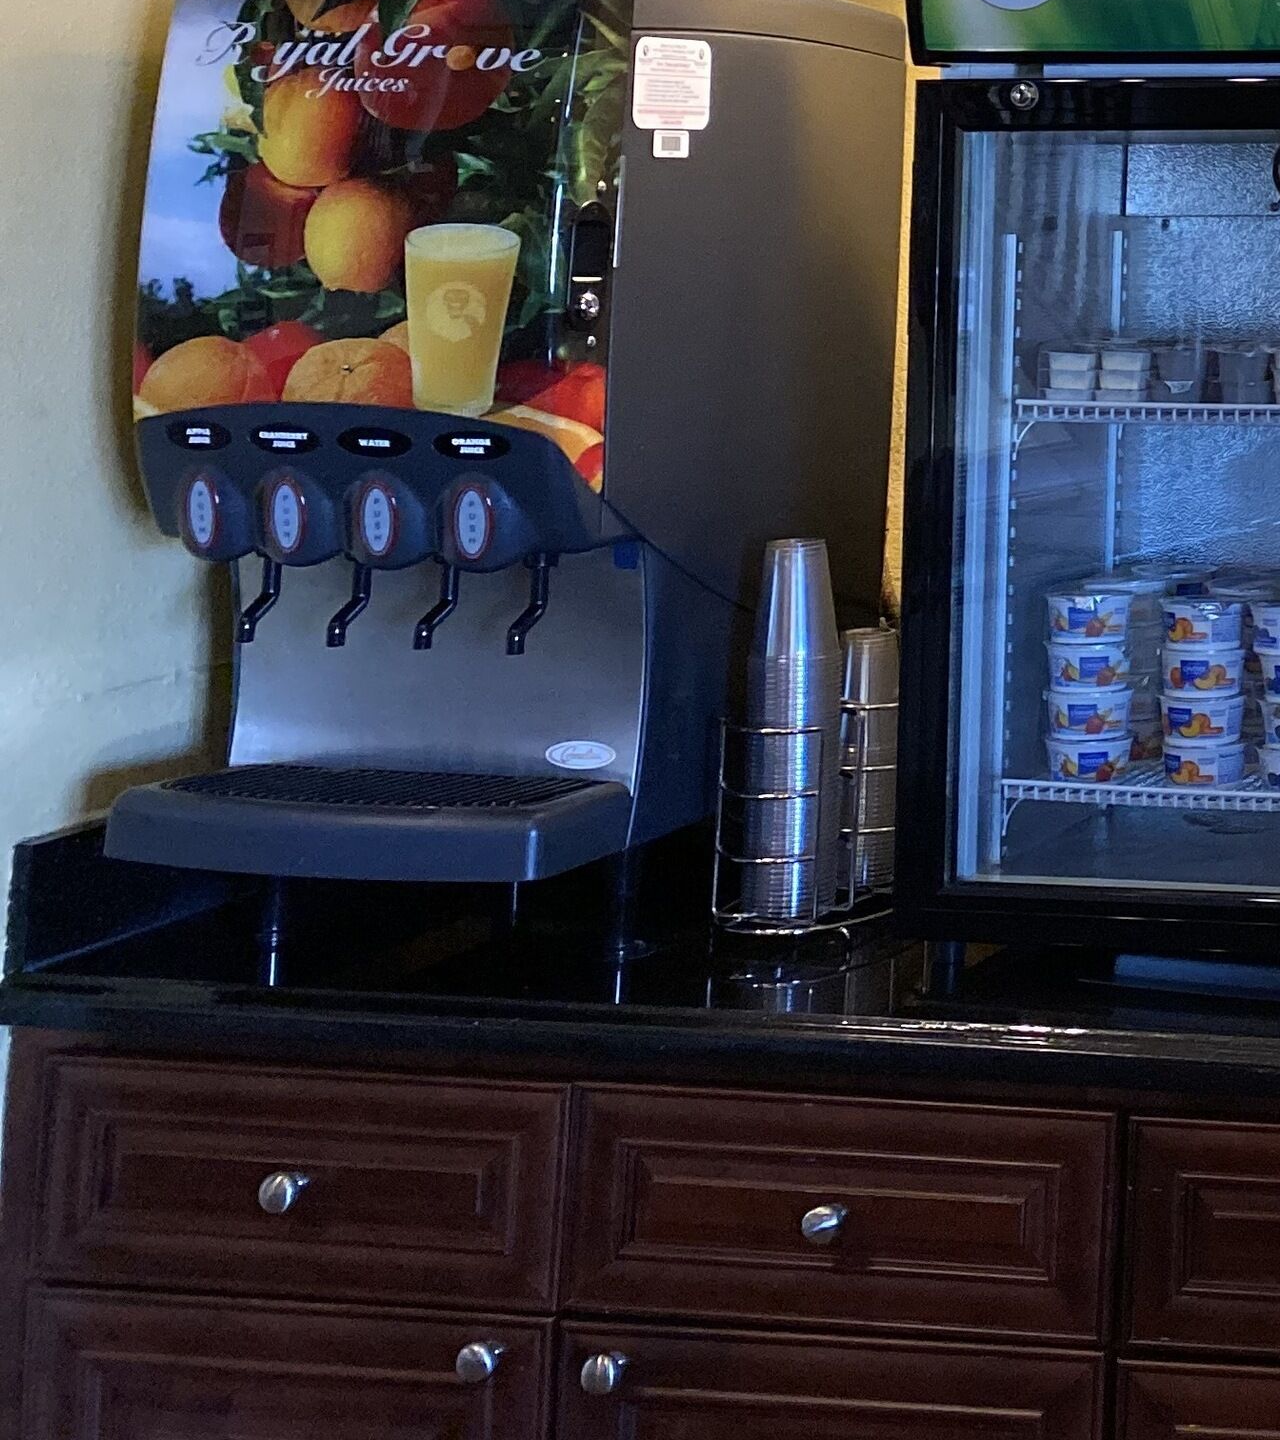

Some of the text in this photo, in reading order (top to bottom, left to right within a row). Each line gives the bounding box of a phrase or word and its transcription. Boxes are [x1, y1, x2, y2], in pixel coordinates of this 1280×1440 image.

[303, 68, 410, 100] Juices
[357, 438, 391, 448] WATER
[450, 437, 492, 447] ORANGE
